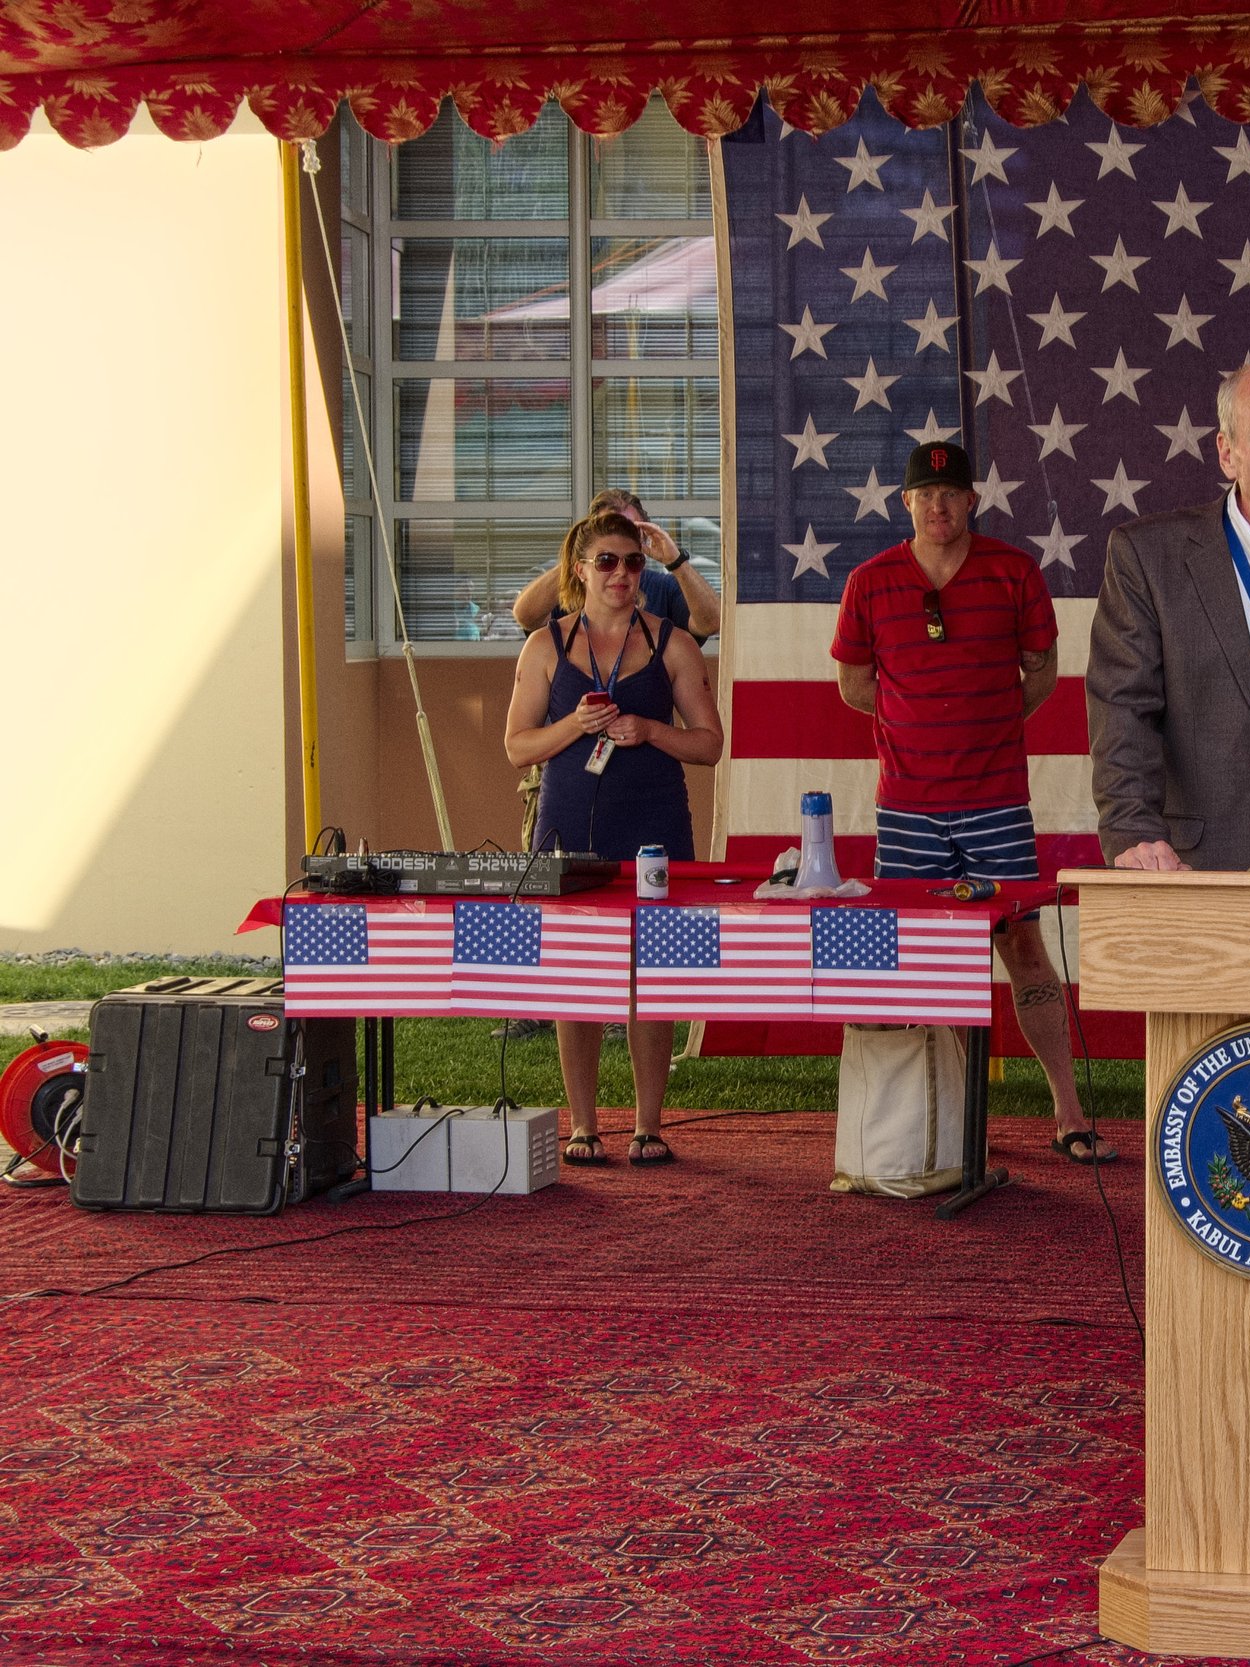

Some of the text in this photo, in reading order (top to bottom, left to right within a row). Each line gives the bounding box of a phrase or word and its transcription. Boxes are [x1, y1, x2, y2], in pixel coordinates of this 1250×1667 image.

[1163, 1103, 1188, 1190] EMBASSY
[1177, 1079, 1200, 1104] OF
[1193, 1048, 1232, 1083] THE
[1186, 1209, 1242, 1261] KABUL
